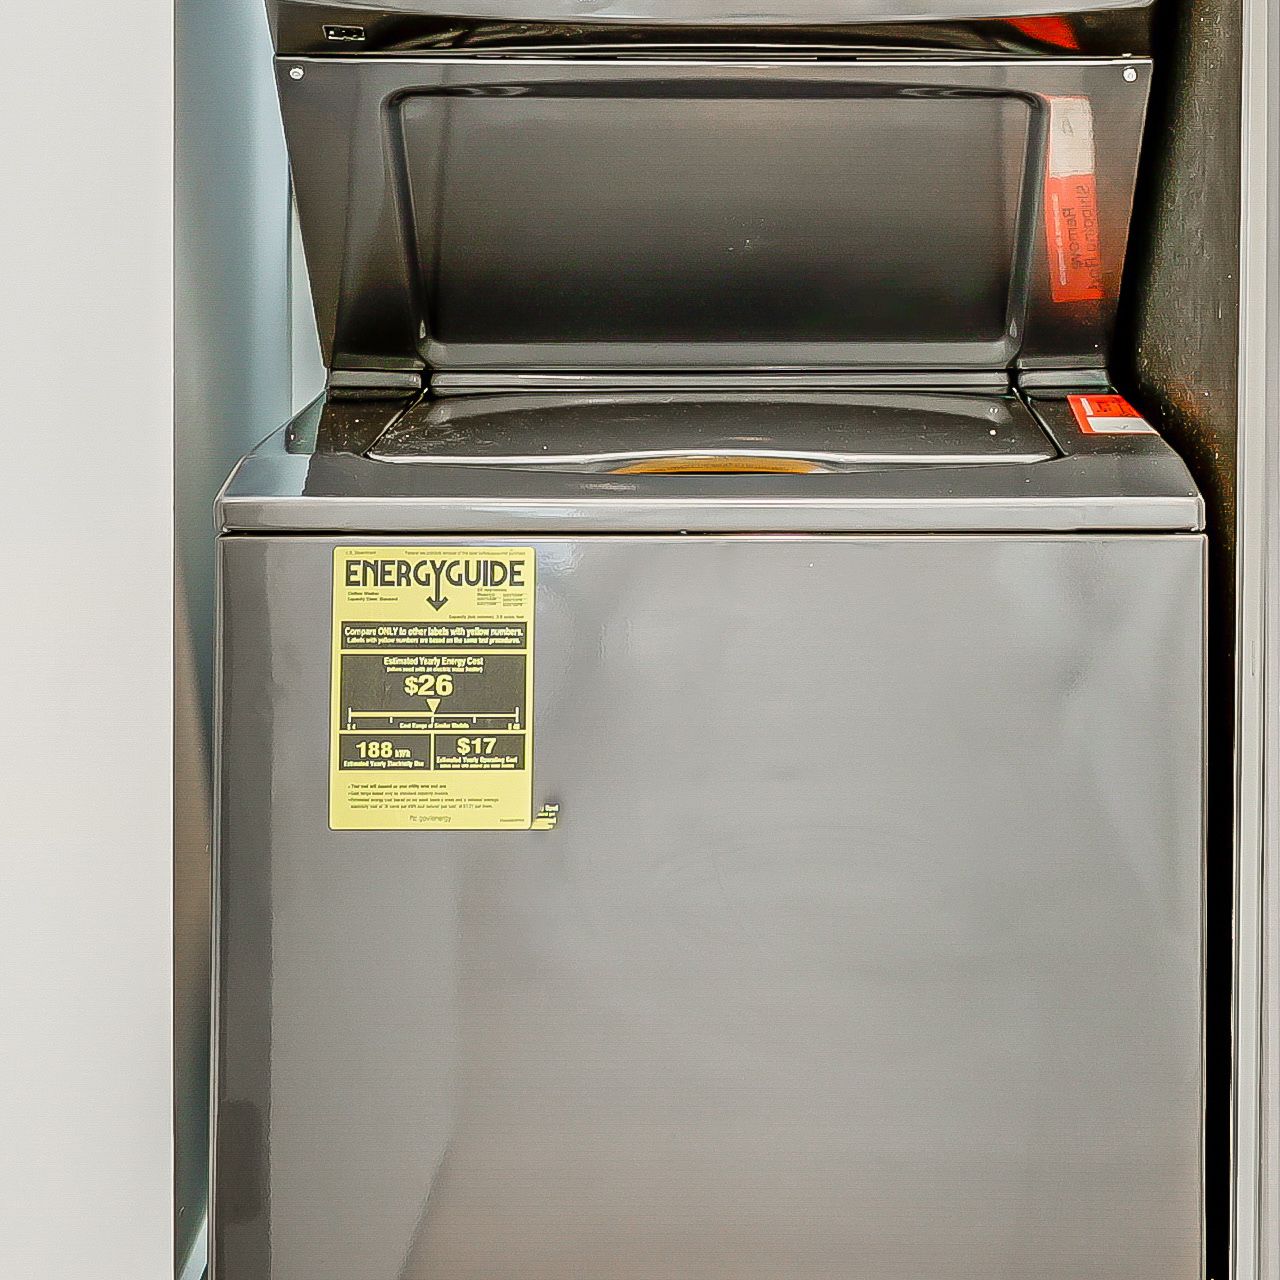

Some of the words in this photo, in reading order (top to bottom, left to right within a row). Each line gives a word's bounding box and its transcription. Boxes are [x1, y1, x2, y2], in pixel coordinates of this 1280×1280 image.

[345, 559, 525, 588] ENERGYGUIDE
[344, 627, 376, 636] Compare
[378, 627, 399, 636] ONLY
[399, 627, 407, 636] to
[408, 627, 427, 636] other
[428, 627, 449, 636] labels
[450, 627, 465, 636] with
[466, 627, 489, 637] yellow
[378, 637, 395, 645] yellow
[384, 657, 418, 665] Estimated
[419, 657, 440, 667] Yearly
[441, 657, 466, 667] Energy
[467, 657, 483, 665] Cost
[404, 673, 453, 696] $26
[356, 741, 392, 758] 188
[457, 737, 497, 755] $17
